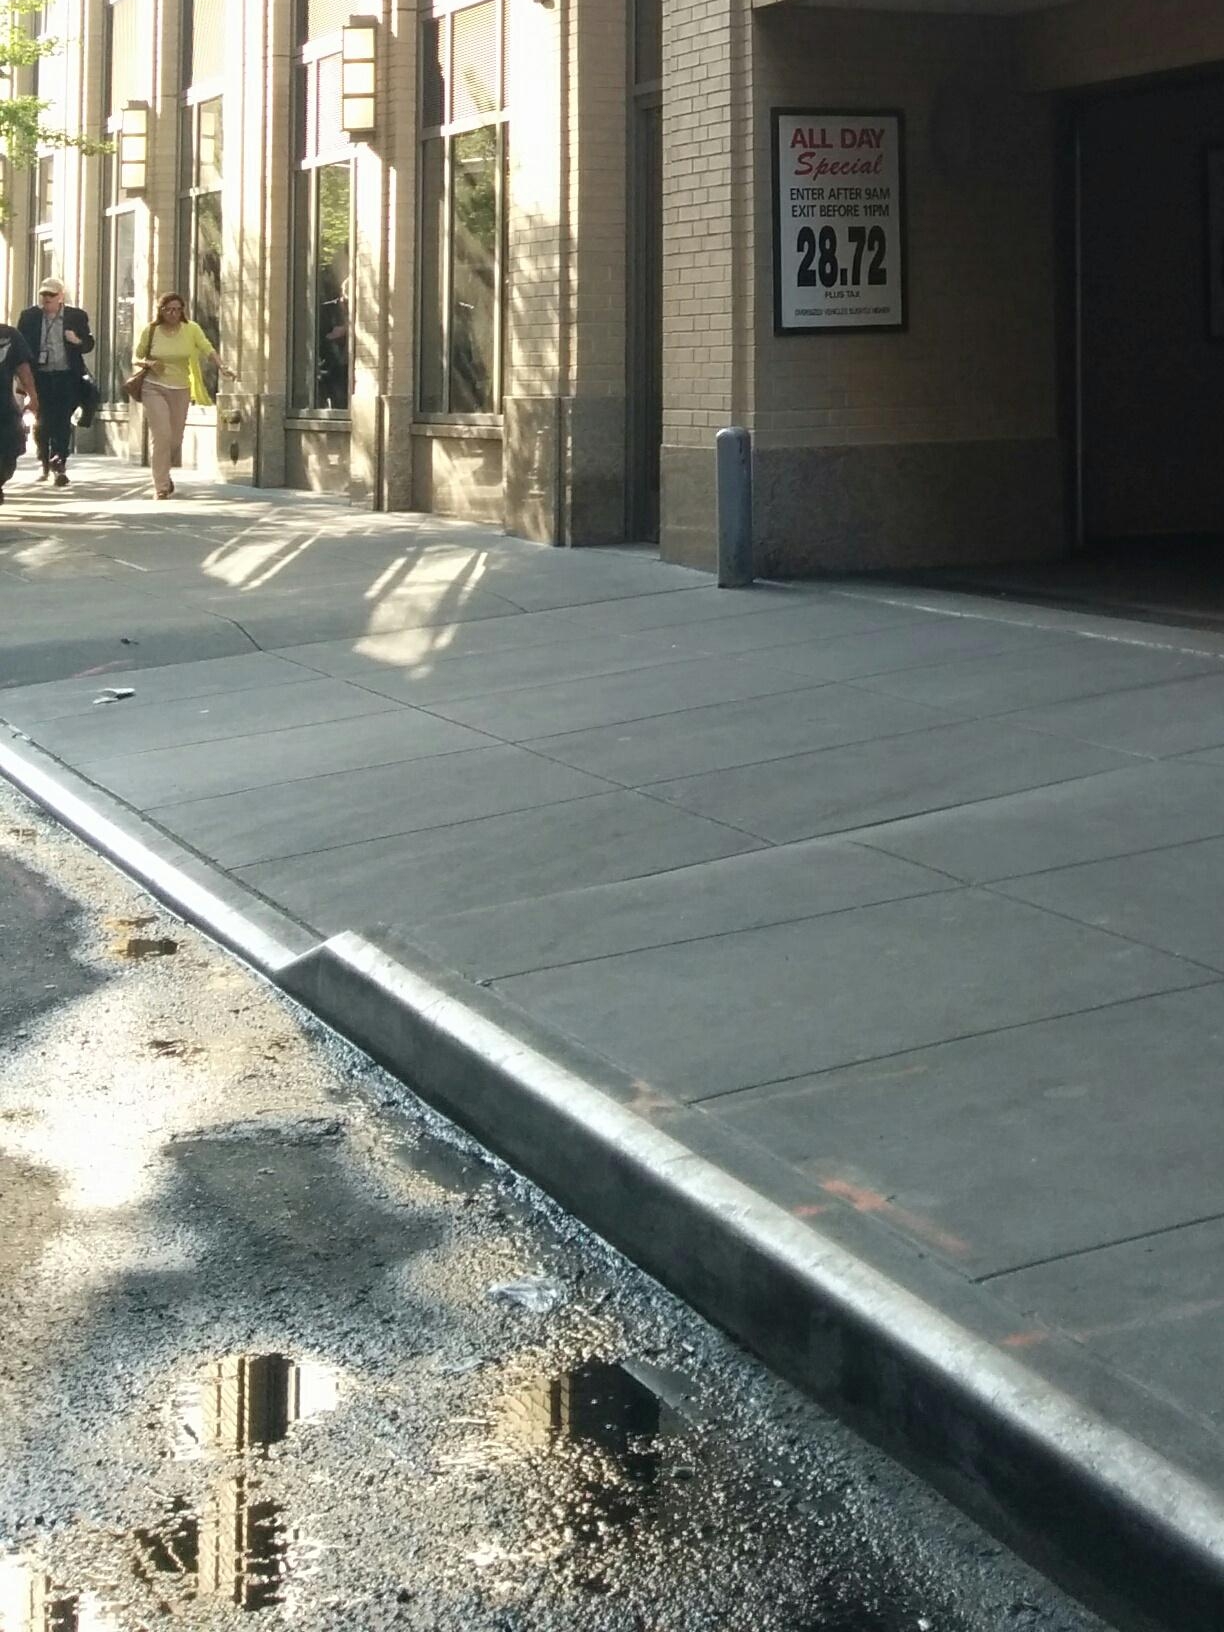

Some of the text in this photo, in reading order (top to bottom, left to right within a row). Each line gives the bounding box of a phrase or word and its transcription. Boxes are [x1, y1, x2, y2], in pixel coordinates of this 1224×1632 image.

[790, 128, 886, 149] ALL DAY
[794, 151, 884, 181] Special
[790, 187, 890, 201] ENTER AFTER 9AM
[792, 204, 890, 218] EXIT BEFORE 11PM
[796, 225, 888, 288] 28.72
[825, 290, 861, 299] PLUS TAX
